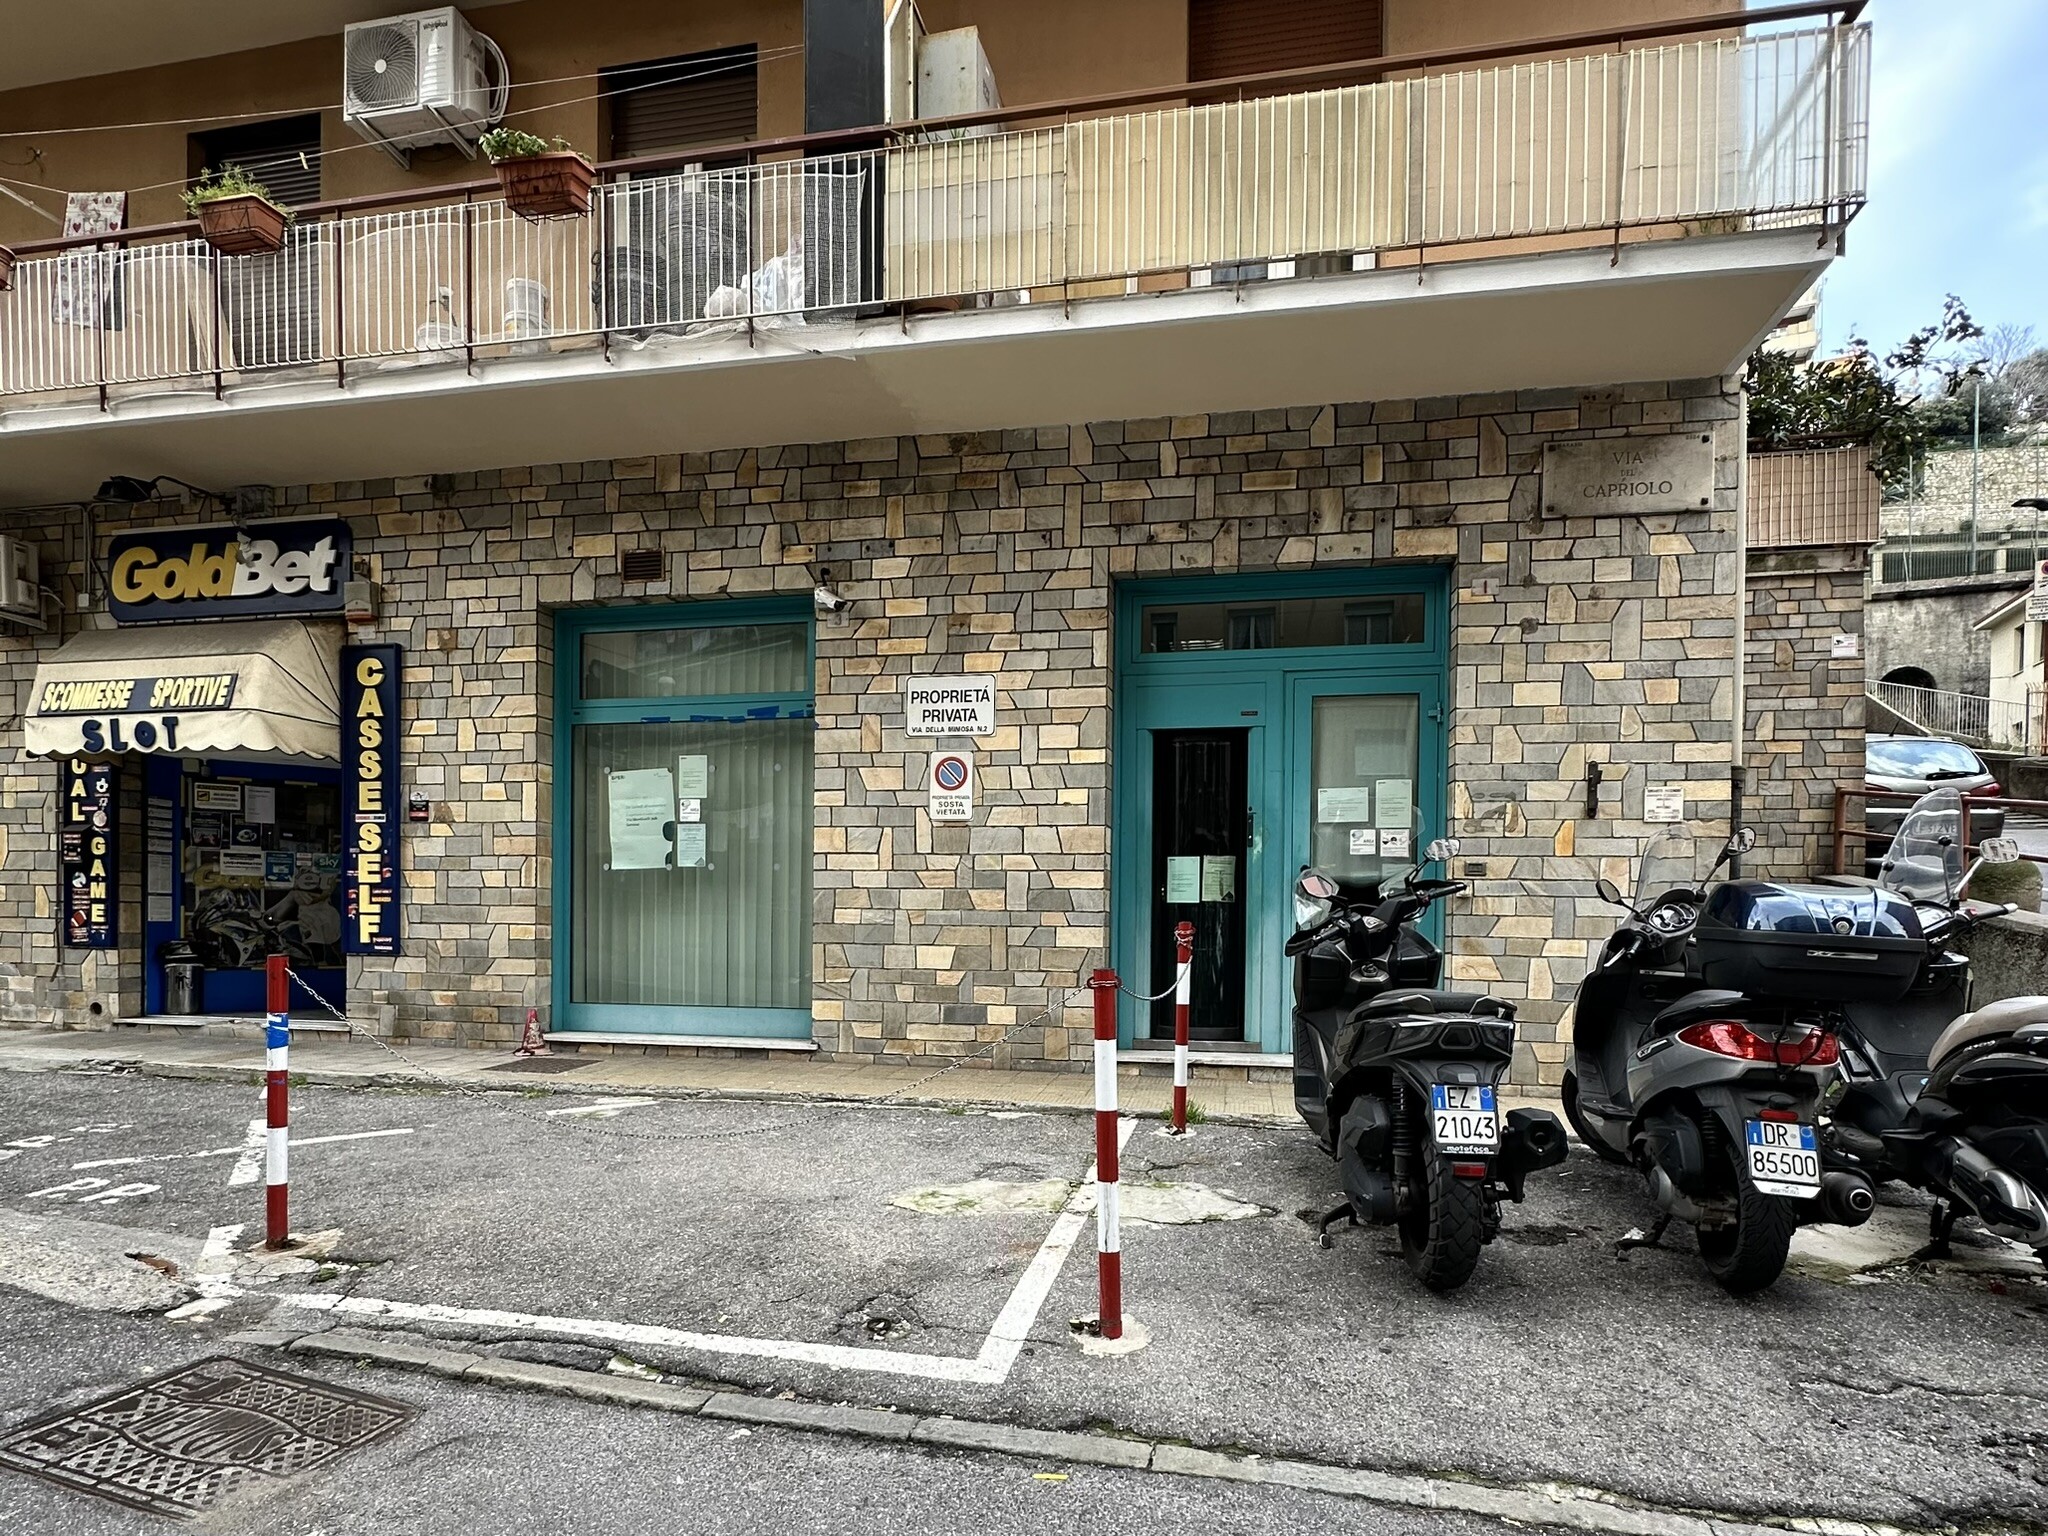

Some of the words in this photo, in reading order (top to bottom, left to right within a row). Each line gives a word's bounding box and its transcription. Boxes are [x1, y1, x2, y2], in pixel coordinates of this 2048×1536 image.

[1613, 452, 1643, 464] VIA
[1621, 469, 1635, 477] DEL
[1583, 480, 1673, 498] CAPRIOLO
[112, 535, 336, 603] GoldBet
[41, 681, 135, 712] SCOMMESSE
[150, 675, 231, 709] SPORTIVE
[922, 708, 978, 722] PRIVATA
[82, 716, 178, 752] SLOT
[319, 856, 340, 868] sky
[90, 837, 107, 923] GAME
[1447, 1087, 1470, 1108] EZ
[1437, 1116, 1494, 1139] 21043
[1763, 1123, 1789, 1146] DR
[1753, 1151, 1817, 1177] 85500
